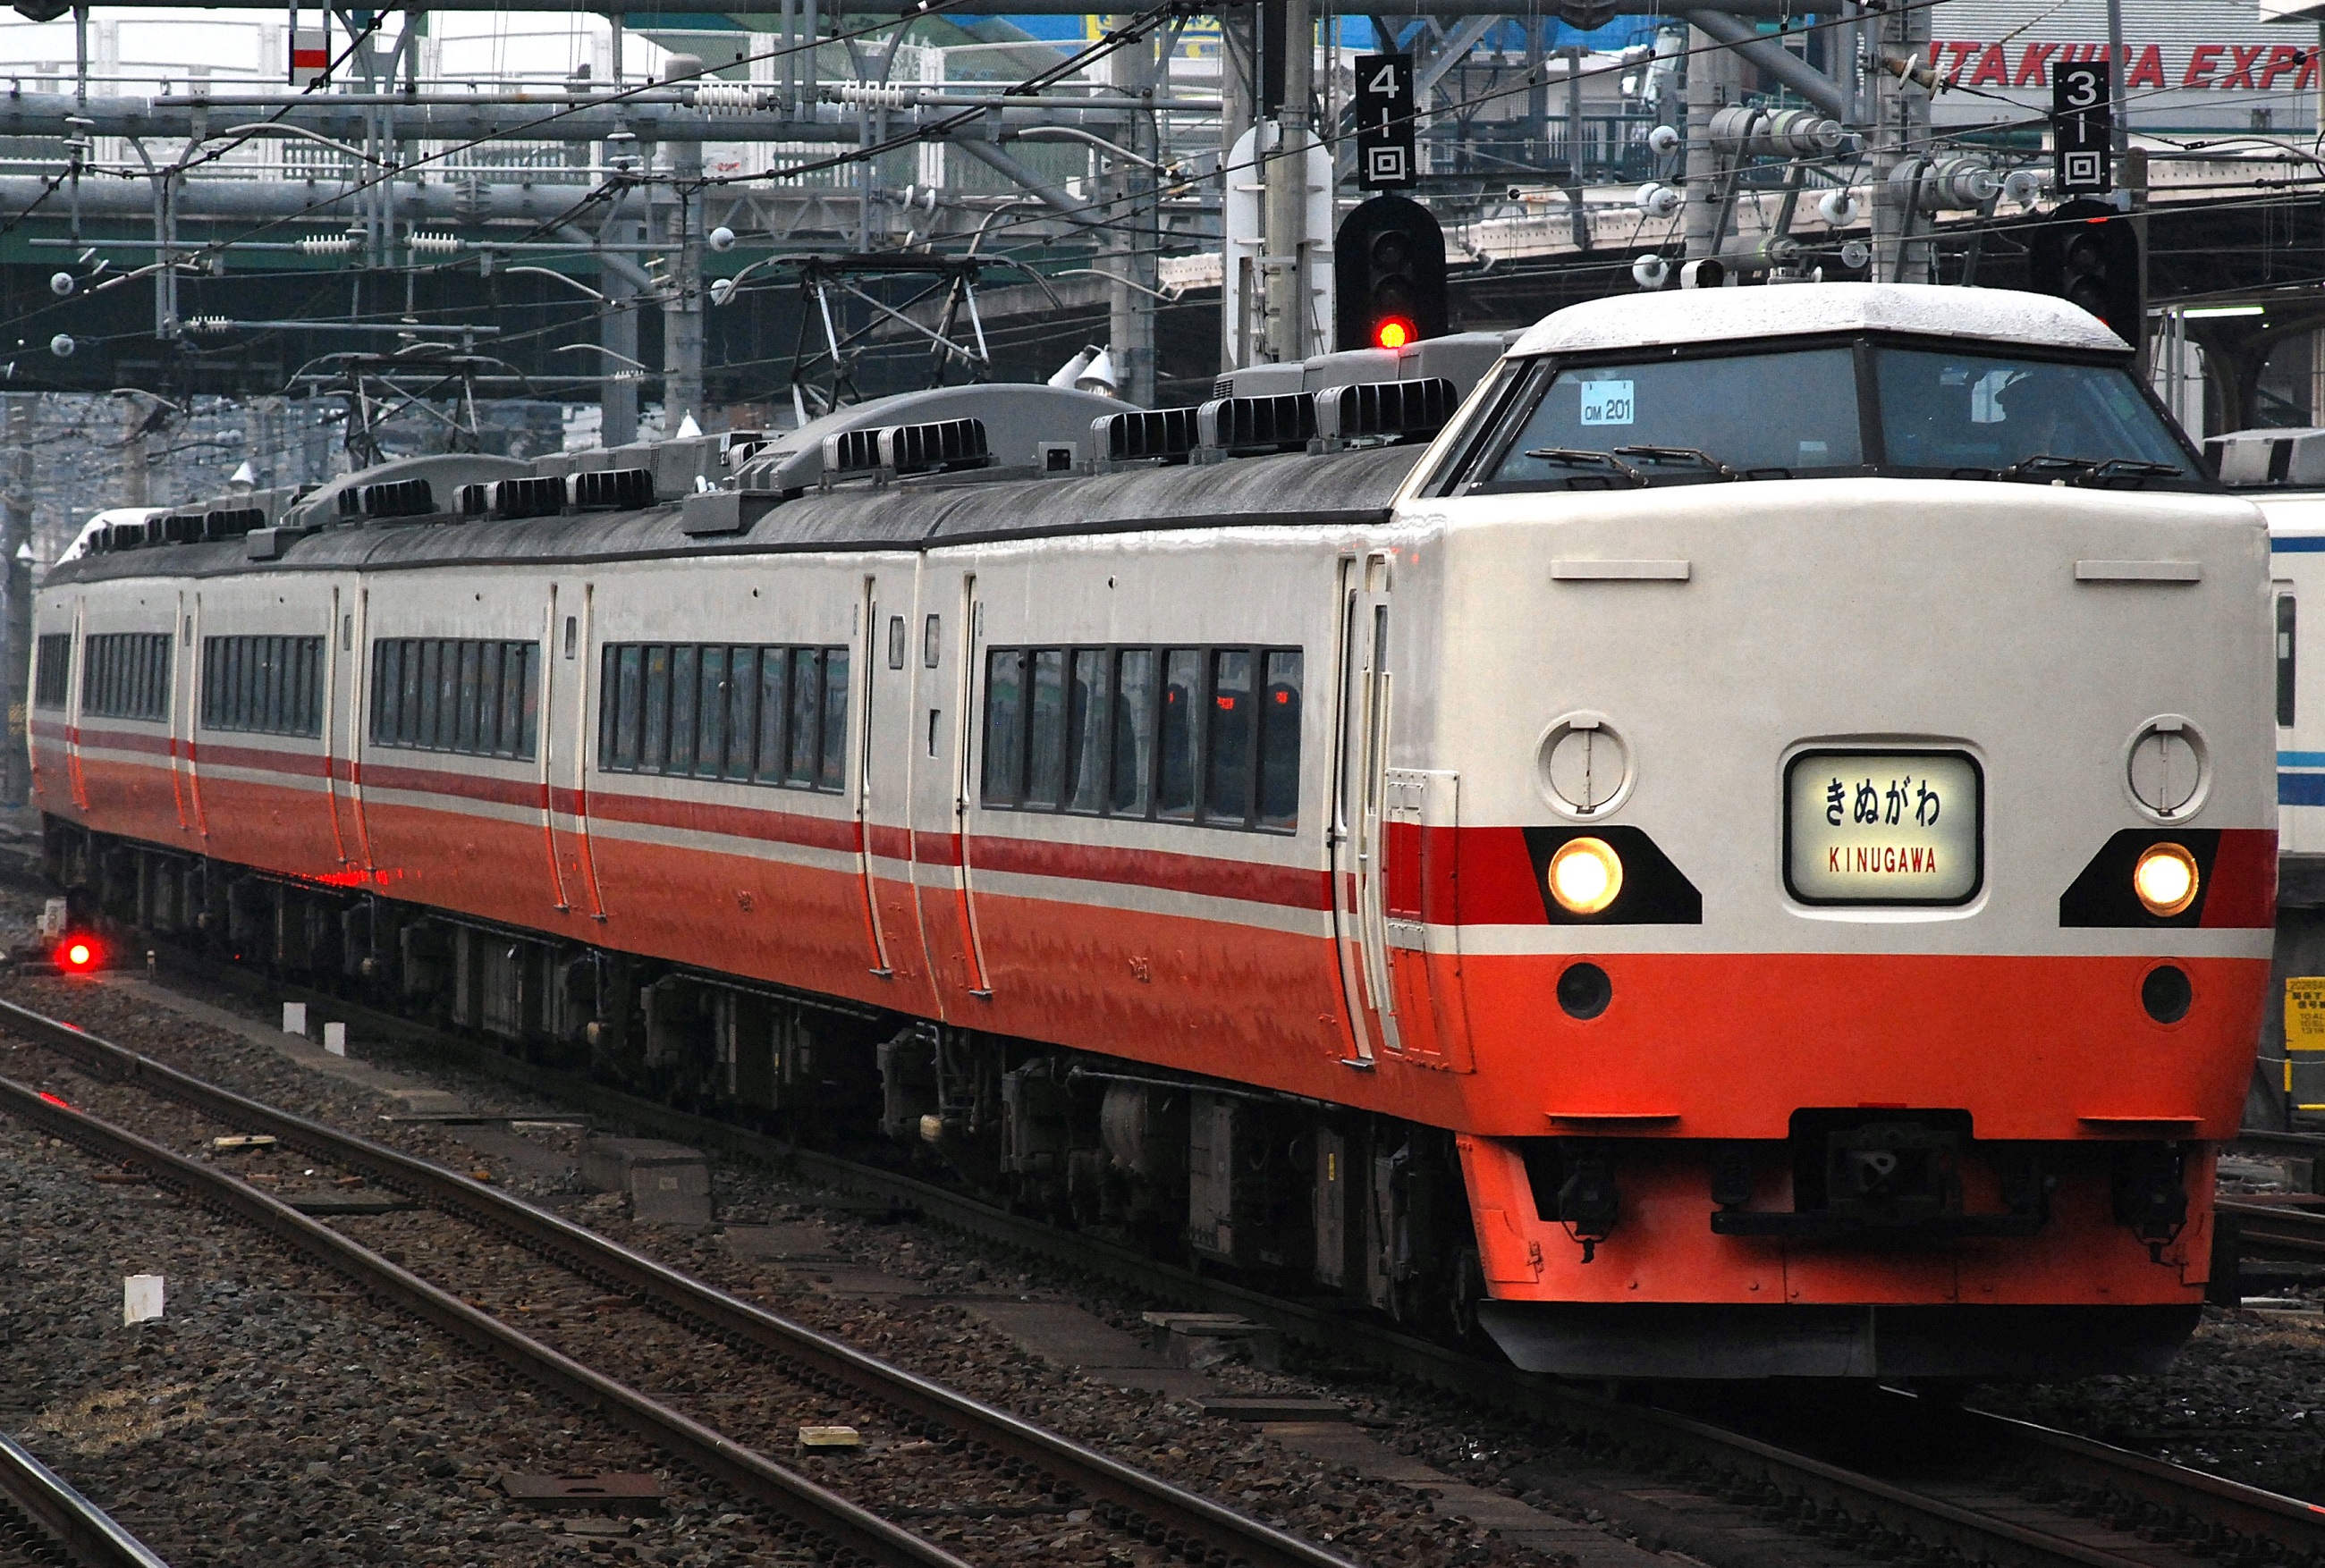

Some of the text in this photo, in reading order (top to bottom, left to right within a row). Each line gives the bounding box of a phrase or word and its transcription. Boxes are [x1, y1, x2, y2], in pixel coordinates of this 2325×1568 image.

[1606, 399, 1630, 419] 201
[1826, 775, 1940, 827] きぬがわ
[1829, 847, 1936, 873] KINUGAWA
